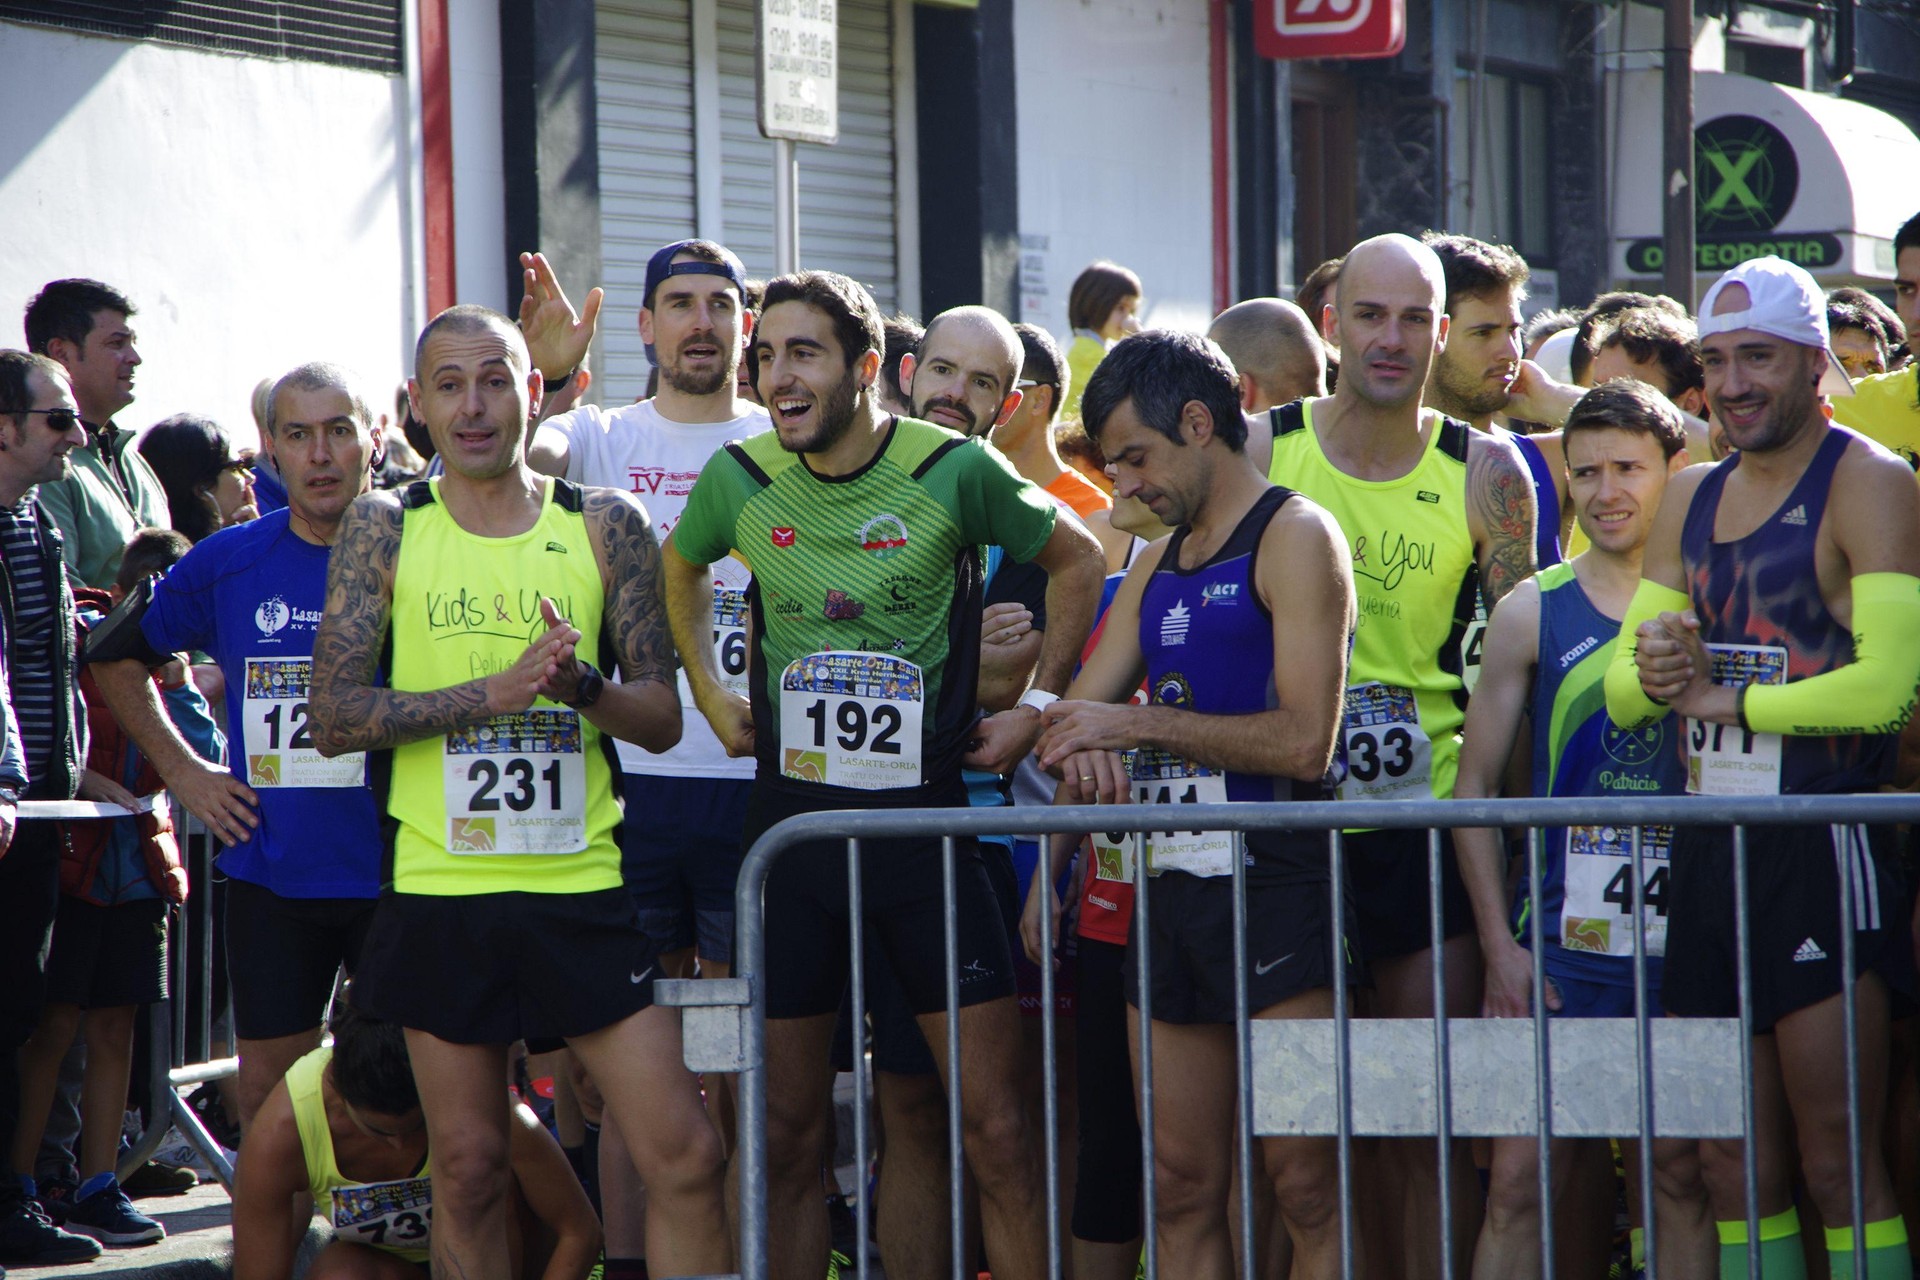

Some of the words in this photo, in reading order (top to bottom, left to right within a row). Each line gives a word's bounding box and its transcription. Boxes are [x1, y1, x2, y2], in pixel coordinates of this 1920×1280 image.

[1643, 241, 1824, 268] OEOPATIA
[629, 473, 666, 495] IV
[1353, 536, 1367, 567] &
[1381, 530, 1435, 590] You
[1212, 583, 1239, 596] ACT
[292, 607, 323, 622] Lasar
[426, 587, 485, 631] Kids
[494, 594, 513, 624] &
[272, 662, 313, 672] Lasarte-
[714, 631, 746, 676] 6
[264, 702, 316, 750] 12
[807, 699, 902, 755] 192
[839, 756, 918, 770] LASARTE-ORIA
[1349, 727, 1413, 782] 33
[468, 758, 562, 811] 231
[508, 817, 582, 827] LASARTE-ORIA
[1158, 840, 1229, 855] LASARTE-ORIA
[1603, 863, 1669, 917] 44
[357, 1206, 432, 1244] 73
